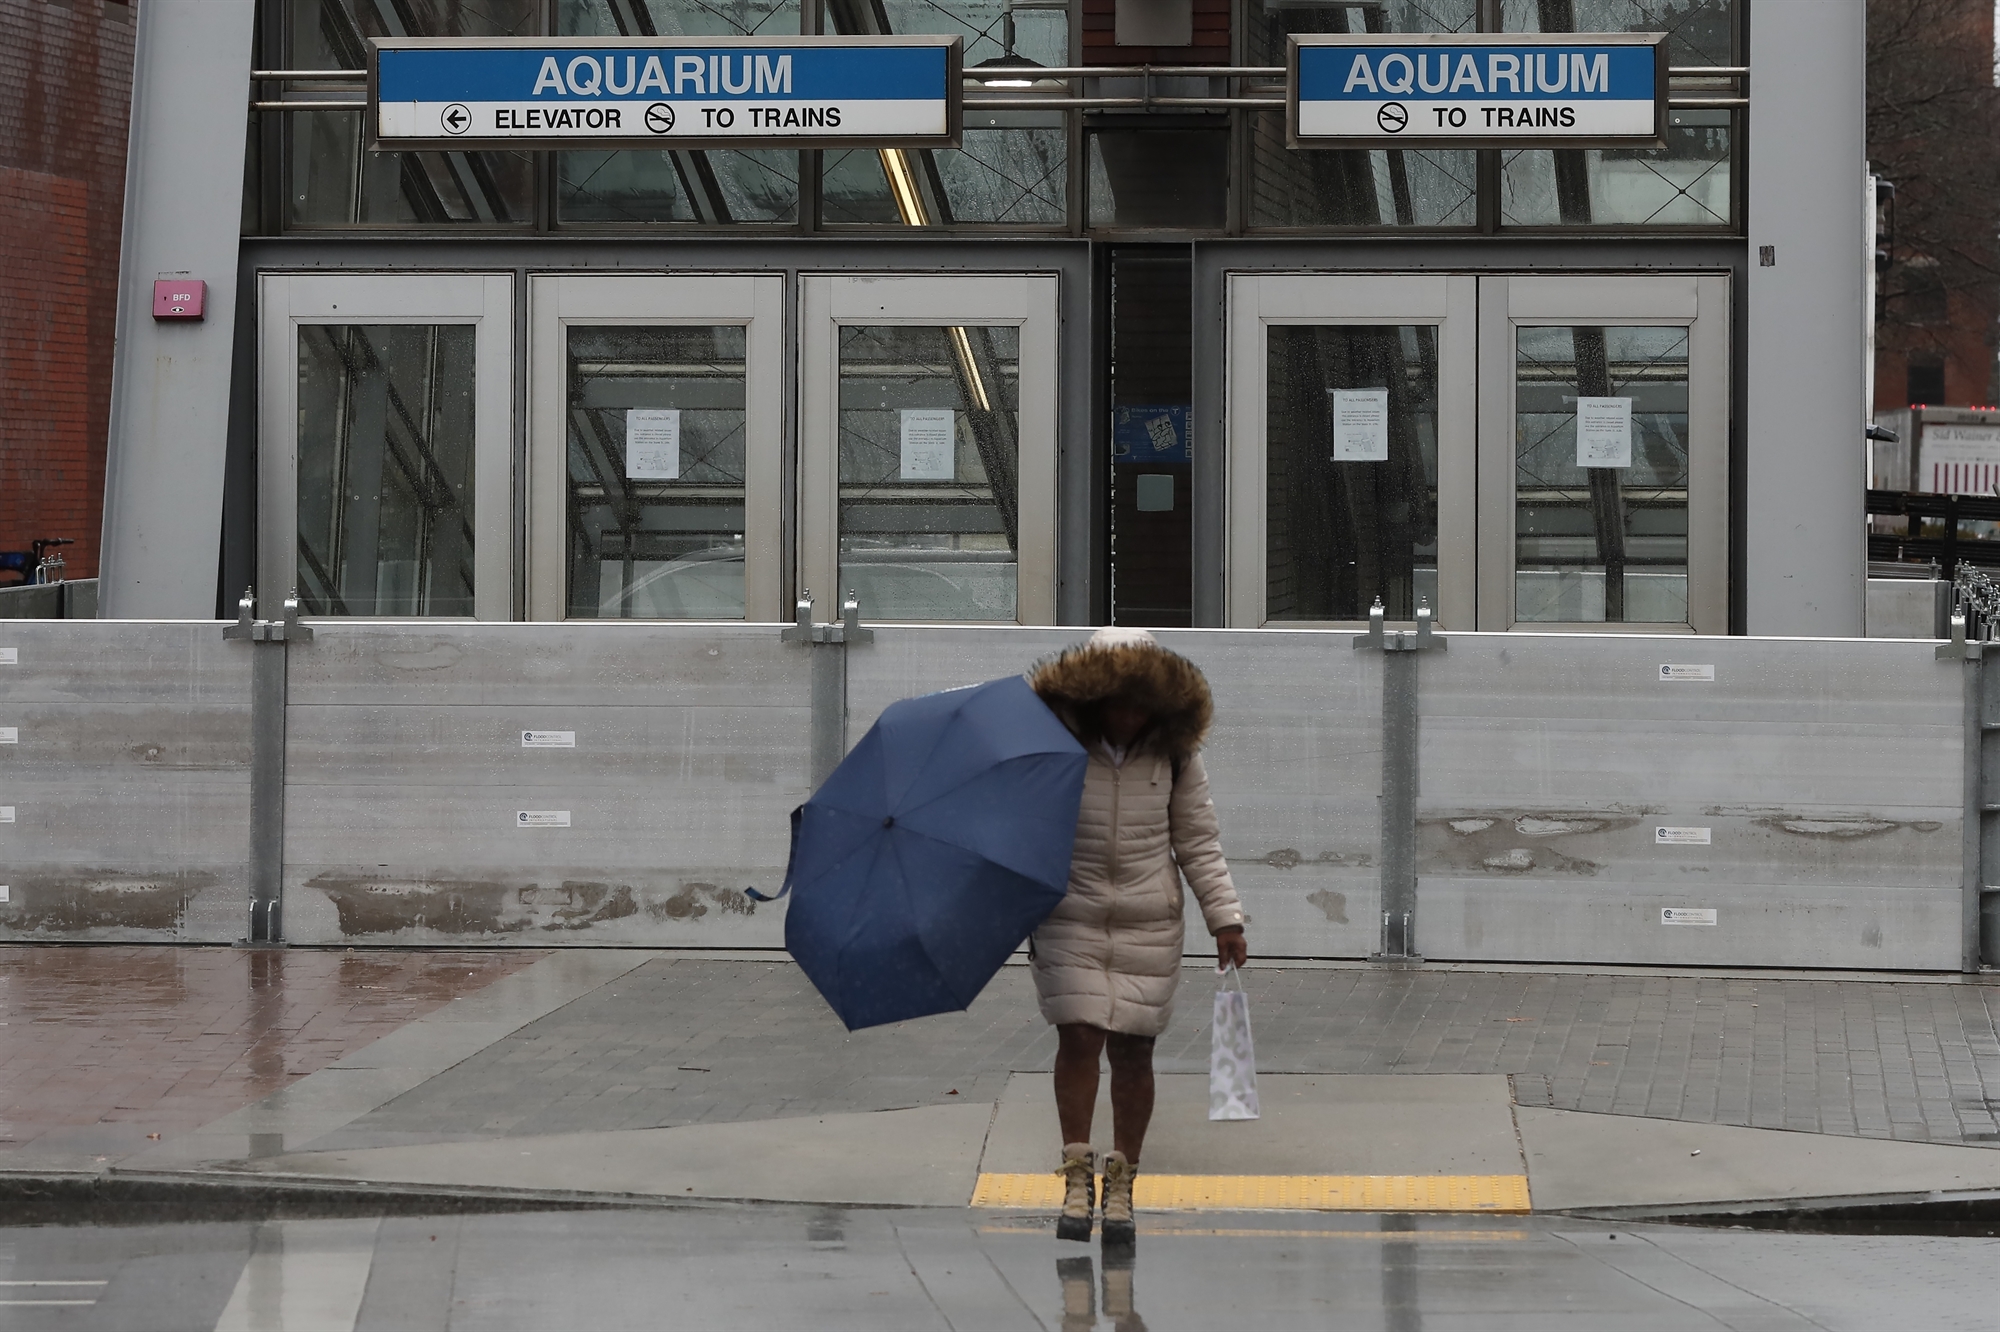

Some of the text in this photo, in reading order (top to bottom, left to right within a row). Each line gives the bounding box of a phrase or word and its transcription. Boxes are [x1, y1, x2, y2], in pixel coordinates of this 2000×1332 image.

[532, 54, 792, 96] AQUARIUM
[1342, 53, 1609, 95] AQUARIUM
[494, 107, 841, 129] ELEVATOR TO TRAINS
[1432, 106, 1576, 128] TO TRAINS
[172, 293, 191, 302] BFD
